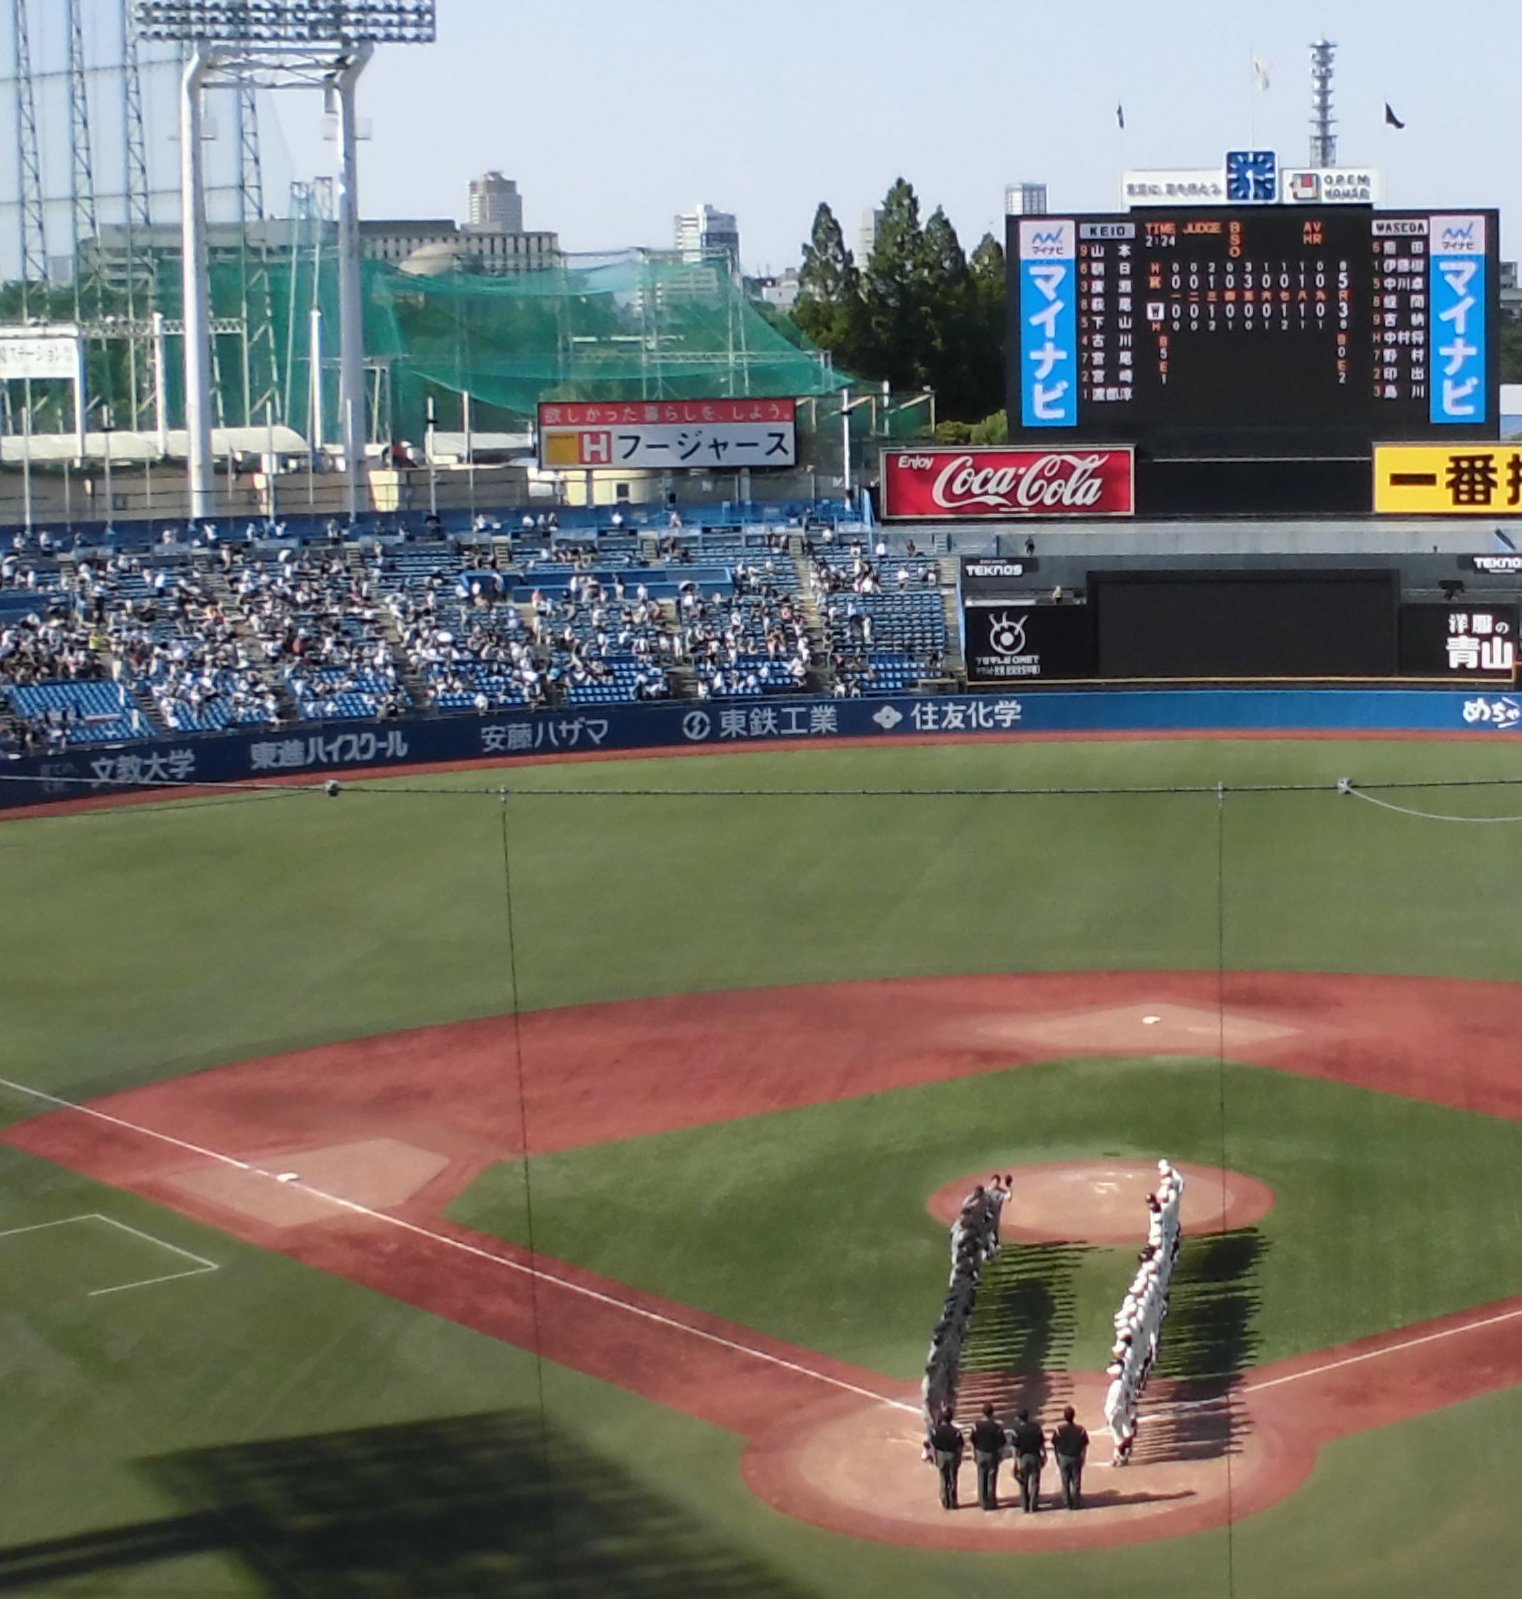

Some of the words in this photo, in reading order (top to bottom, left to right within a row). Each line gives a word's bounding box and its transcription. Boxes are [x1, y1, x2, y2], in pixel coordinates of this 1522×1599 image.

[1324, 174, 1370, 185] OPEN
[1090, 226, 1126, 236] KEIO
[1145, 223, 1176, 234] TIME
[1183, 222, 1222, 234] JUDGE
[1303, 222, 1322, 233] AV
[1376, 223, 1425, 233] WASEDA
[1032, 246, 1063, 255] マイナビ
[1145, 236, 1176, 247] 2:24
[1442, 241, 1475, 250] マイナビ
[1171, 275, 1181, 288] 0
[1189, 275, 1199, 288] 0
[1208, 275, 1214, 288] 1
[1225, 275, 1235, 288] 0
[1244, 275, 1253, 288] 3
[1262, 274, 1271, 288] 0
[1279, 274, 1289, 288] 0
[1299, 274, 1305, 287] 1
[1315, 274, 1325, 287] 0
[1338, 272, 1349, 289] 5
[1171, 304, 1181, 318] 0
[1189, 304, 1199, 318] 0
[1209, 305, 1215, 317] 1
[1225, 304, 1235, 317] 0
[1244, 303, 1254, 317] 0
[1262, 303, 1272, 317] 0
[1281, 303, 1287, 317] 1
[1299, 303, 1305, 316] 1
[1315, 303, 1325, 316] 0
[1338, 301, 1349, 317] 3
[1028, 265, 1069, 419] マイナビ
[1438, 261, 1479, 415] マイナビ
[618, 430, 789, 461] フージャース
[898, 455, 934, 470] Enjoy
[932, 454, 1109, 508] Coca-Cola
[966, 565, 1023, 576] TEKNOS
[1449, 614, 1509, 634] 洋服の
[1445, 635, 1513, 669] 青山
[719, 705, 839, 738] 東鉄工業
[911, 700, 1023, 730] 住友化学
[481, 717, 609, 752] 安藤ハザマ
[250, 731, 408, 770] 東進ハイスクール
[90, 749, 195, 788] 文教大学
